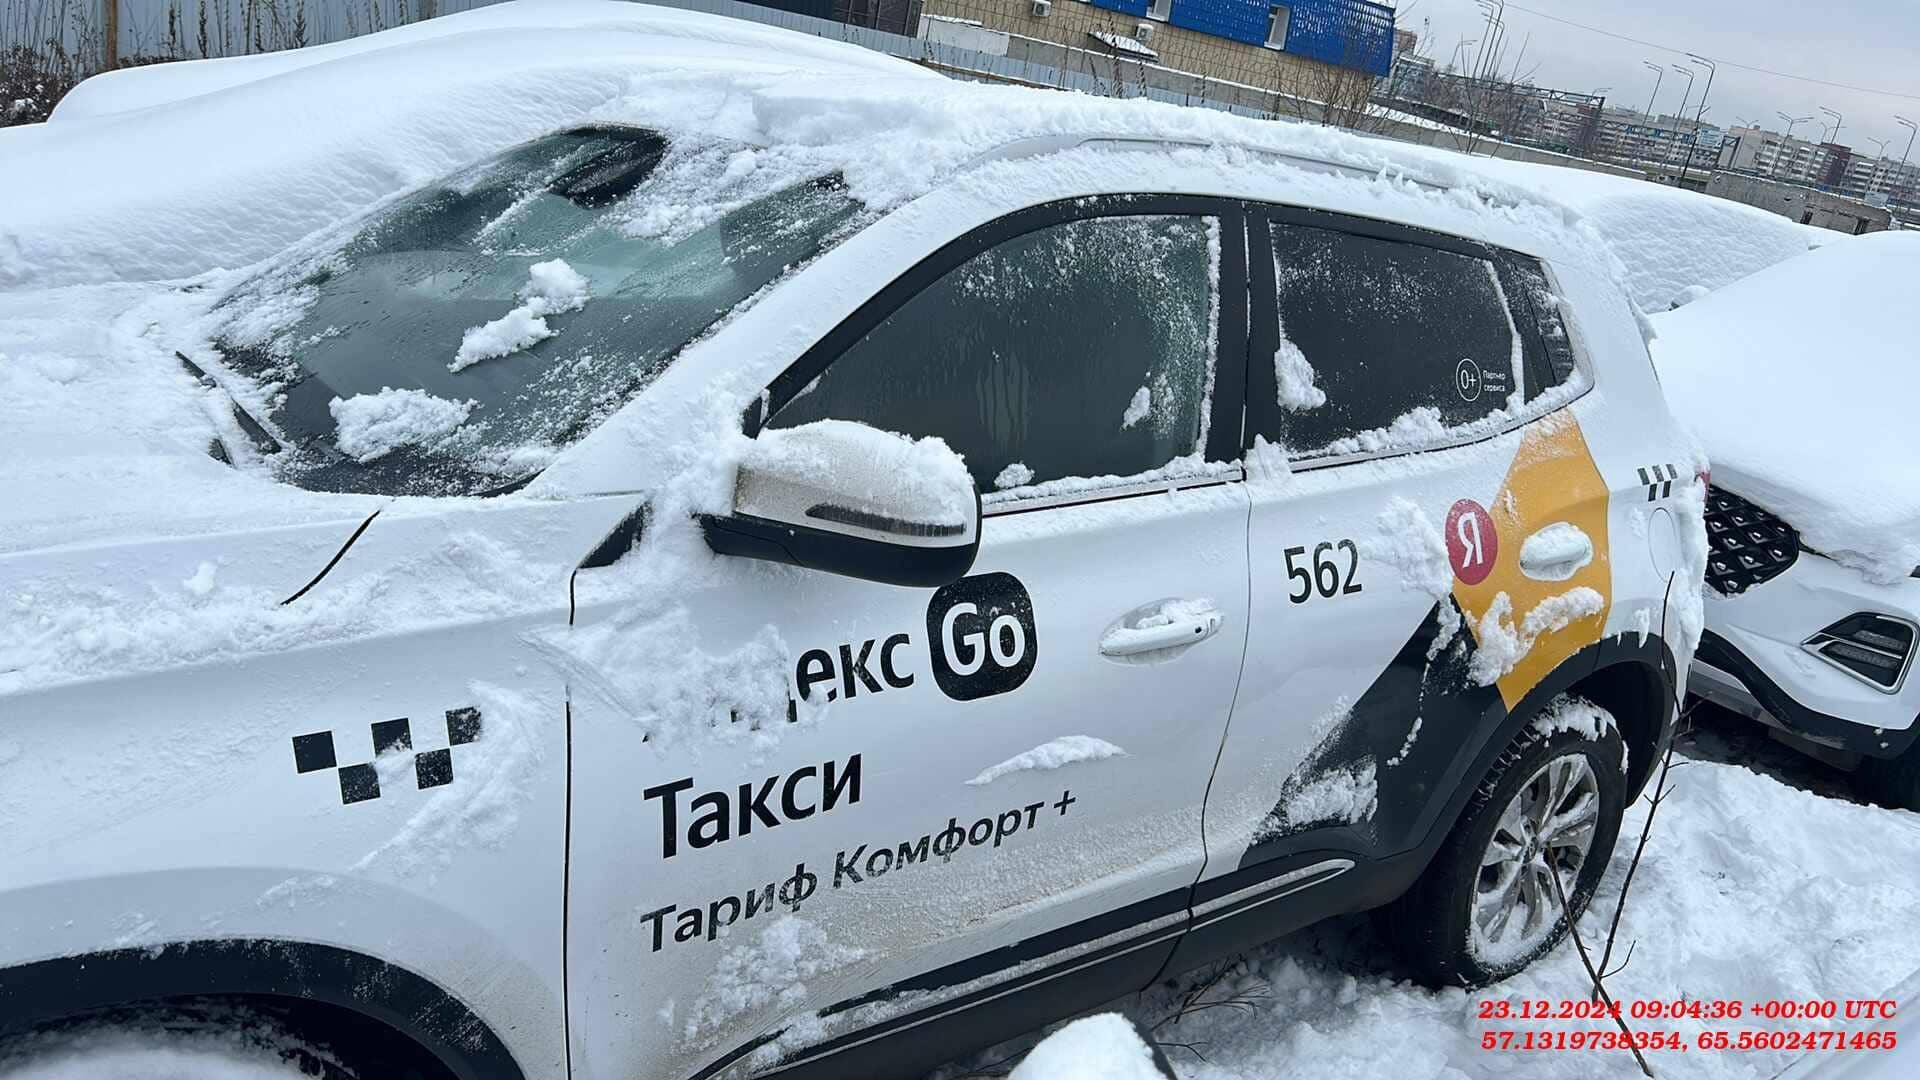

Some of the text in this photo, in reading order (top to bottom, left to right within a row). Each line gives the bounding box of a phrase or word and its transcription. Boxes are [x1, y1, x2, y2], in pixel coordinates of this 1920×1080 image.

[1460, 369, 1477, 390] 0+
[1284, 539, 1363, 604] 562
[1456, 511, 1486, 569] Я
[941, 602, 1027, 676] Go
[643, 753, 862, 859] Такси
[640, 862, 819, 953] Тариф
[832, 800, 1046, 889] Комфорт
